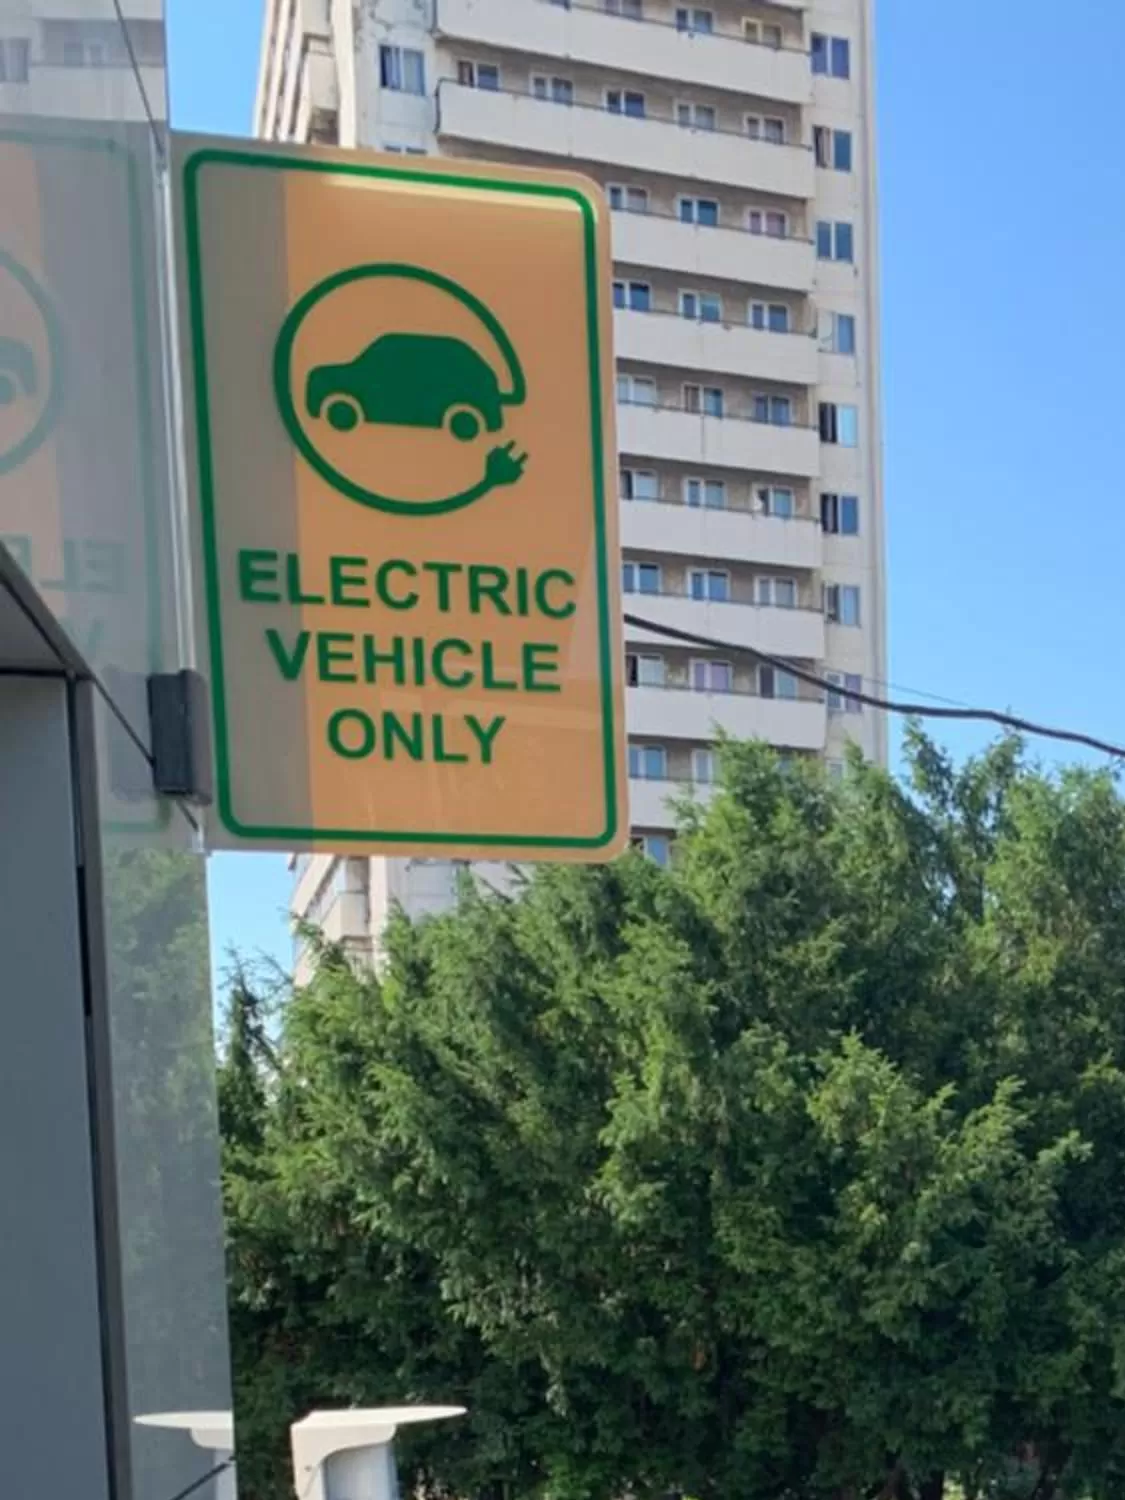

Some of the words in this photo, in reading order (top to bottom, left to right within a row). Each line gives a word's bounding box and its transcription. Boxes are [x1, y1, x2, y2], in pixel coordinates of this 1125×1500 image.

[238, 549, 577, 620] ELECTRIC
[265, 628, 561, 693] VEHICLE
[327, 708, 506, 765] ONLY
